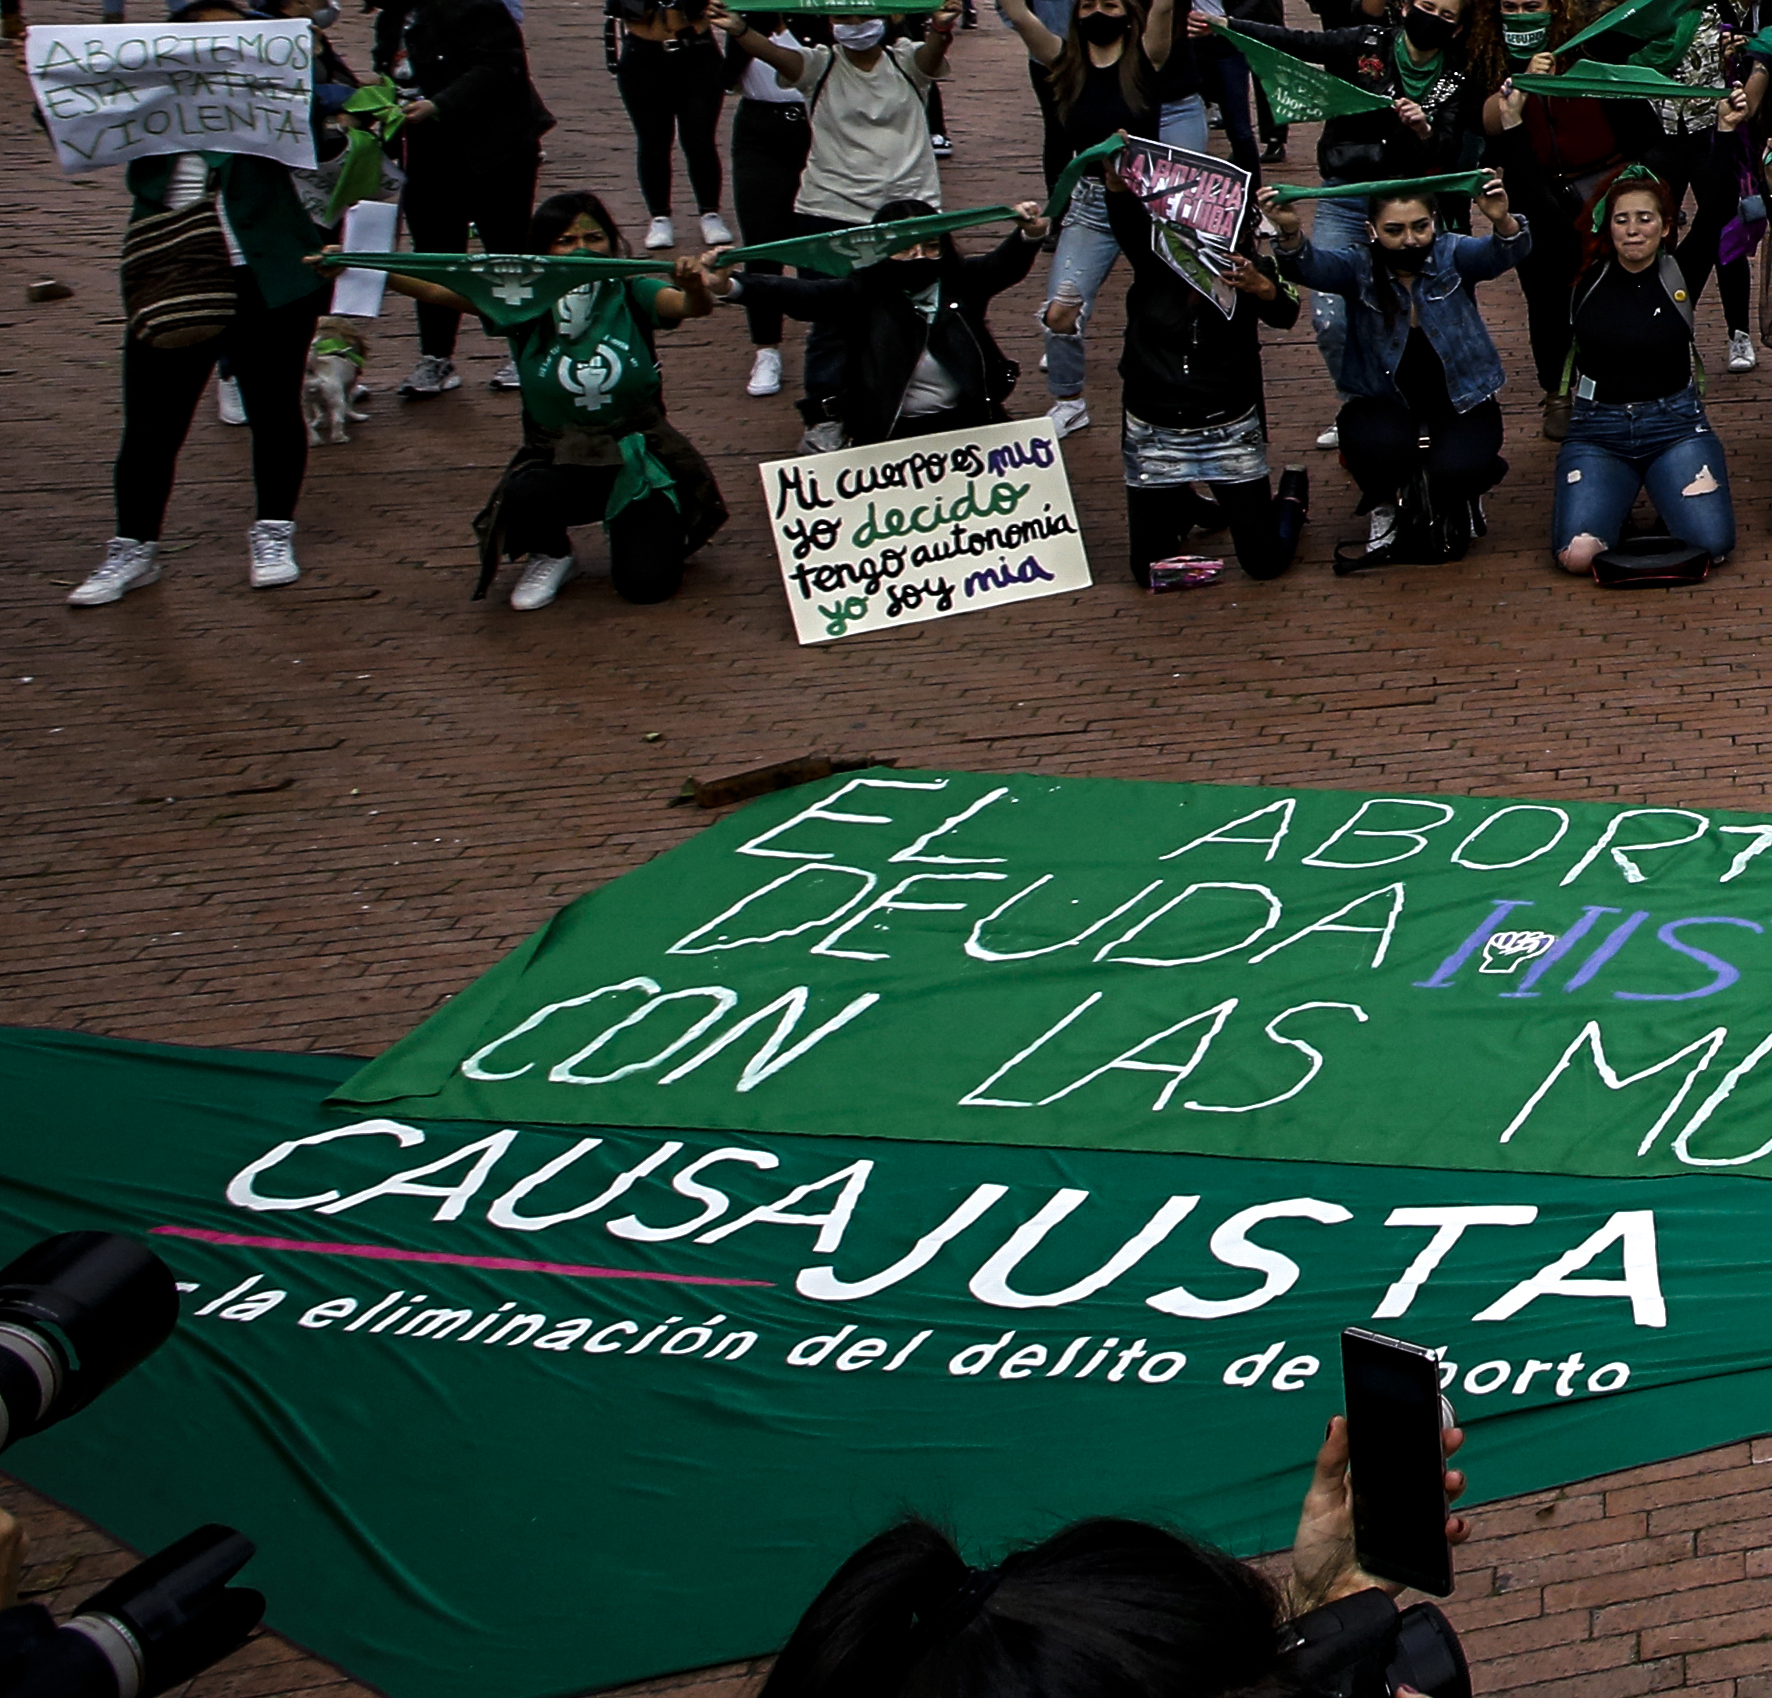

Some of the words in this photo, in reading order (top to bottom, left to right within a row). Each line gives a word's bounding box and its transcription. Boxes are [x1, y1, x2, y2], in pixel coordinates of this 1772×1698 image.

[36, 33, 312, 81] ABORTEMOS
[42, 78, 142, 120] ESTA
[61, 102, 306, 160] VIOLENTA
[776, 466, 835, 520] Mi
[836, 452, 949, 500] cuerpo
[950, 444, 986, 479] es
[782, 516, 844, 561] yo
[851, 480, 1031, 550] decido
[788, 545, 908, 600] tengo
[818, 595, 870, 637] yo
[885, 576, 956, 618] soy
[733, 776, 1010, 865] EL
[664, 862, 1407, 971] DEUDA
[460, 975, 880, 1093] CON
[956, 990, 1370, 1114] LAS
[795, 1182, 1668, 1330] JUSTA
[193, 1273, 289, 1324] la
[297, 1285, 760, 1362] eliminación
[785, 1323, 935, 1375] del
[946, 1328, 1189, 1385] delito
[1222, 1340, 1320, 1393] de
[1434, 1343, 1632, 1398] borto
